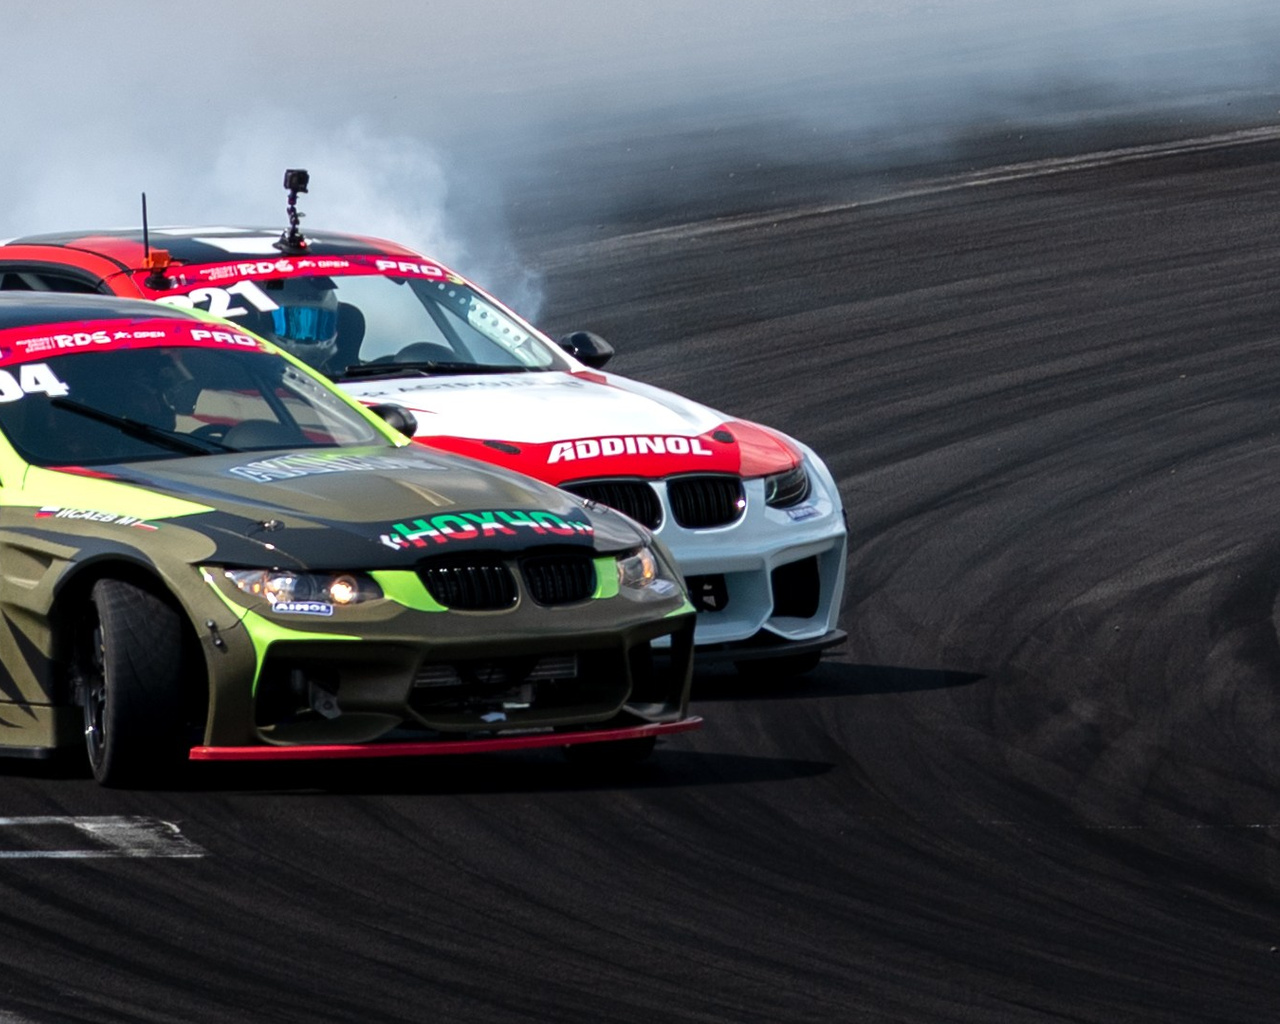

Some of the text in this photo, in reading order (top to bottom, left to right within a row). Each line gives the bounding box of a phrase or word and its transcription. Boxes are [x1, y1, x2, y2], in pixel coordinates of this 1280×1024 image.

[317, 260, 349, 268] OPEN
[375, 259, 443, 277] PRO
[54, 329, 257, 349] RDS OPEN PRO
[546, 436, 713, 464] ADDINOL
